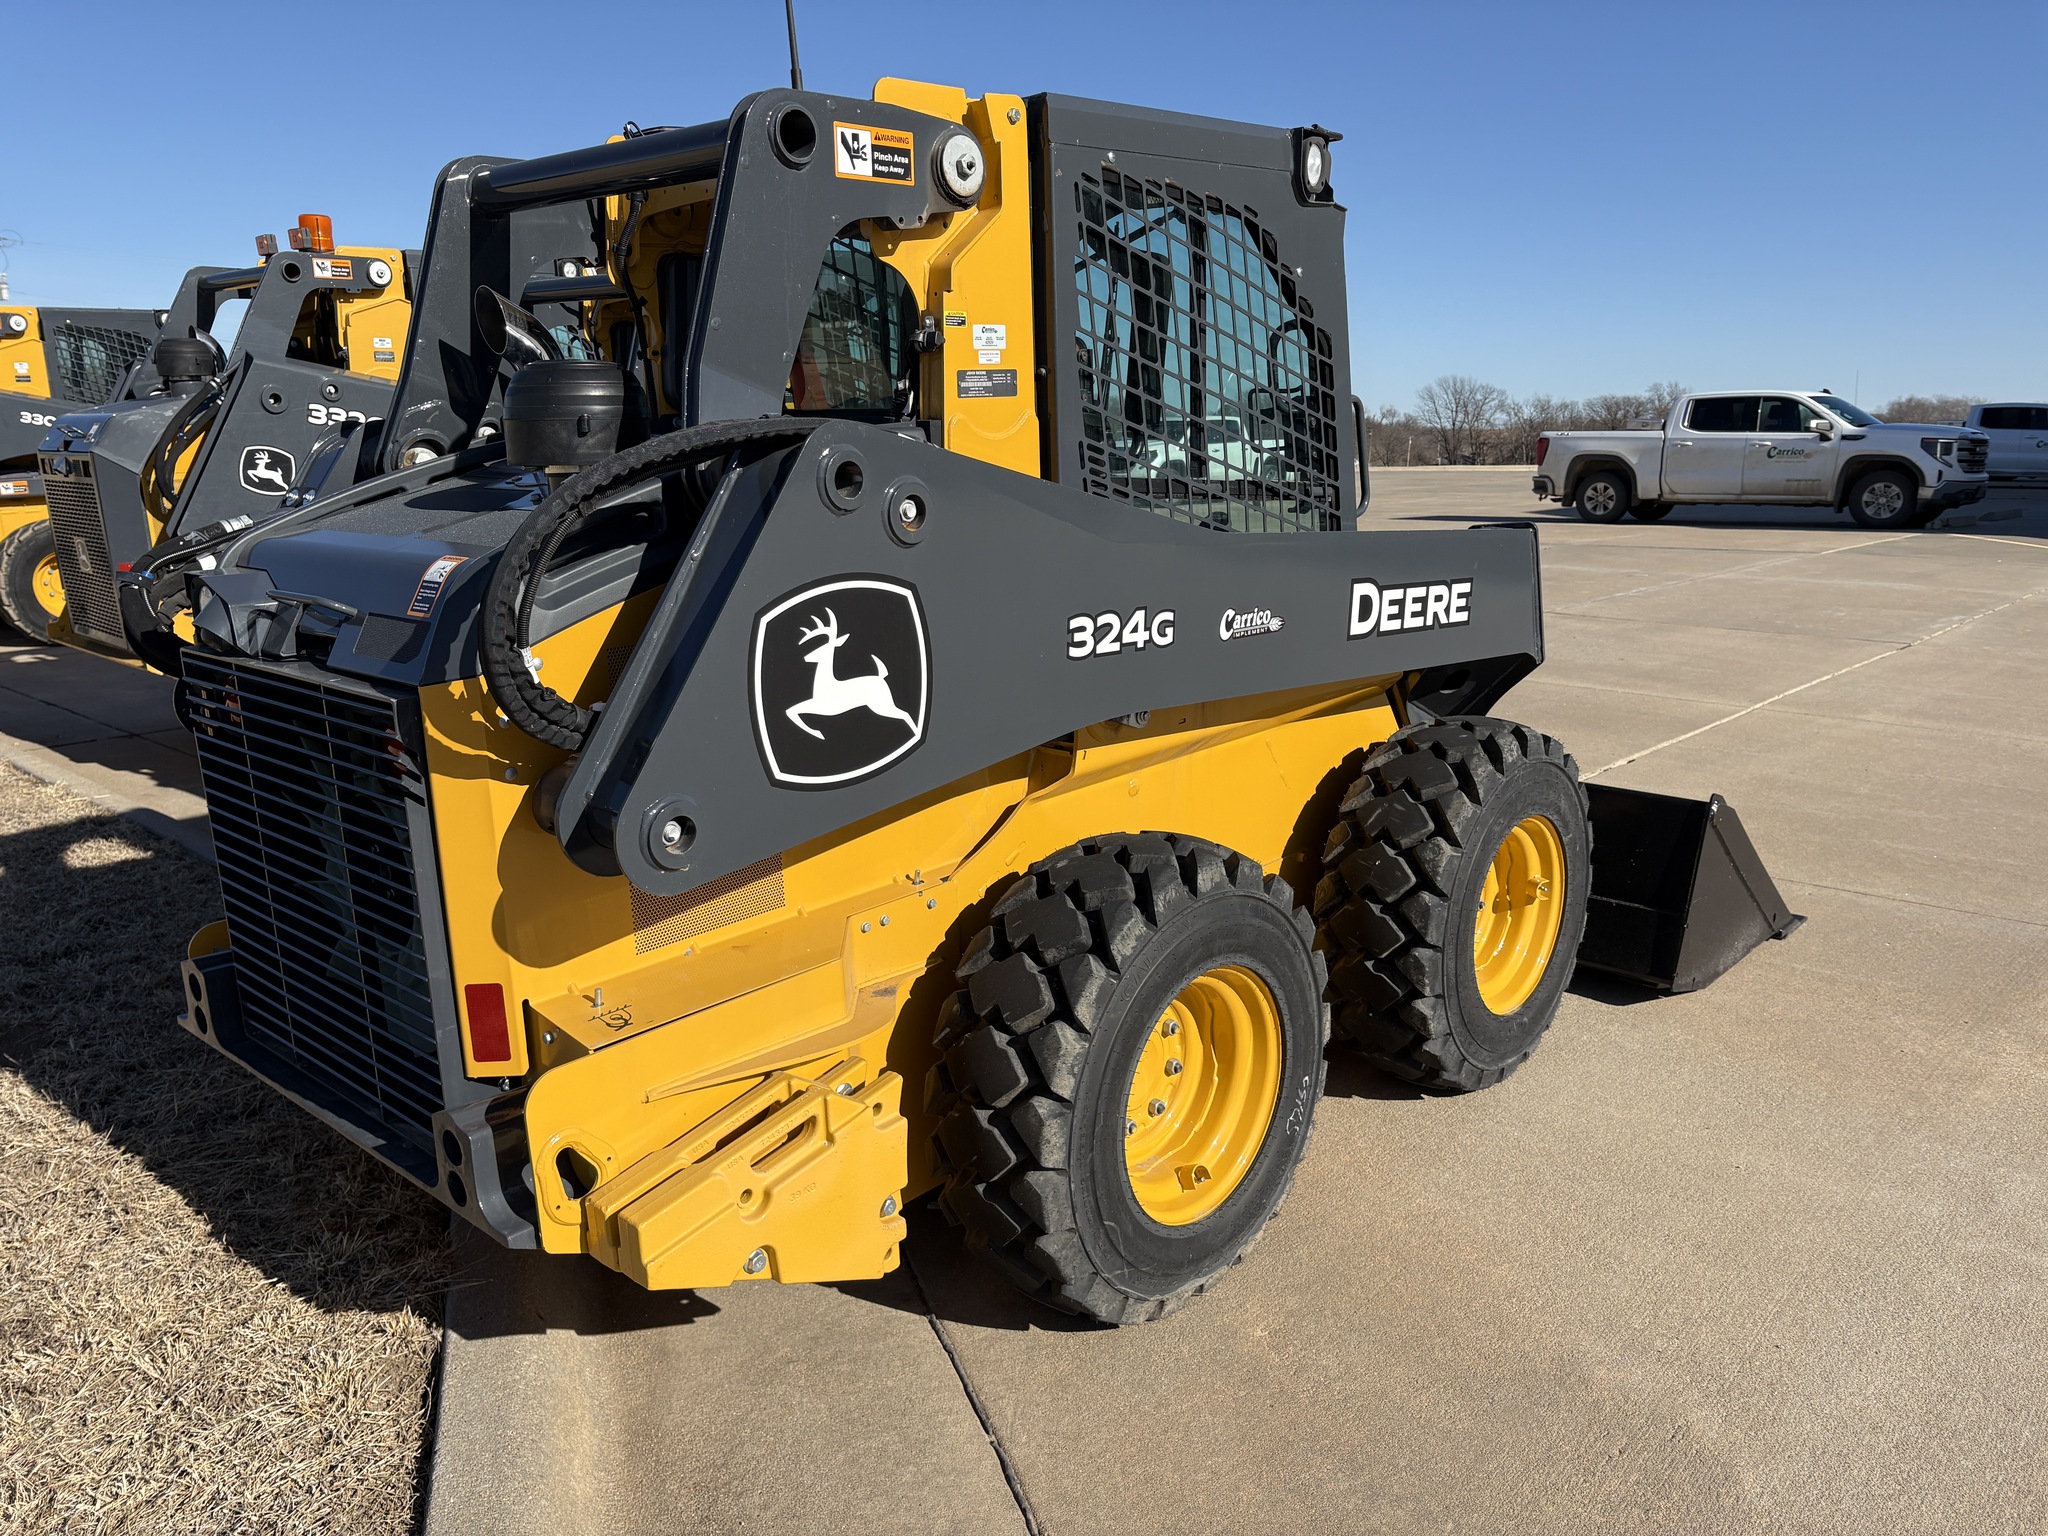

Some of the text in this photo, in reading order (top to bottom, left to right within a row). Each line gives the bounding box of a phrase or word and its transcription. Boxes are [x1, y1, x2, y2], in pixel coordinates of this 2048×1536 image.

[880, 133, 910, 145] WARNING
[874, 151, 909, 164] Pinch Area
[874, 163, 905, 175] Keep Away
[1767, 446, 1805, 459] Carrico
[1349, 582, 1472, 636] DEERE
[1219, 607, 1271, 641] Carrico
[1068, 609, 1175, 659] 324G
[1233, 626, 1268, 639] IMPLEMENT
